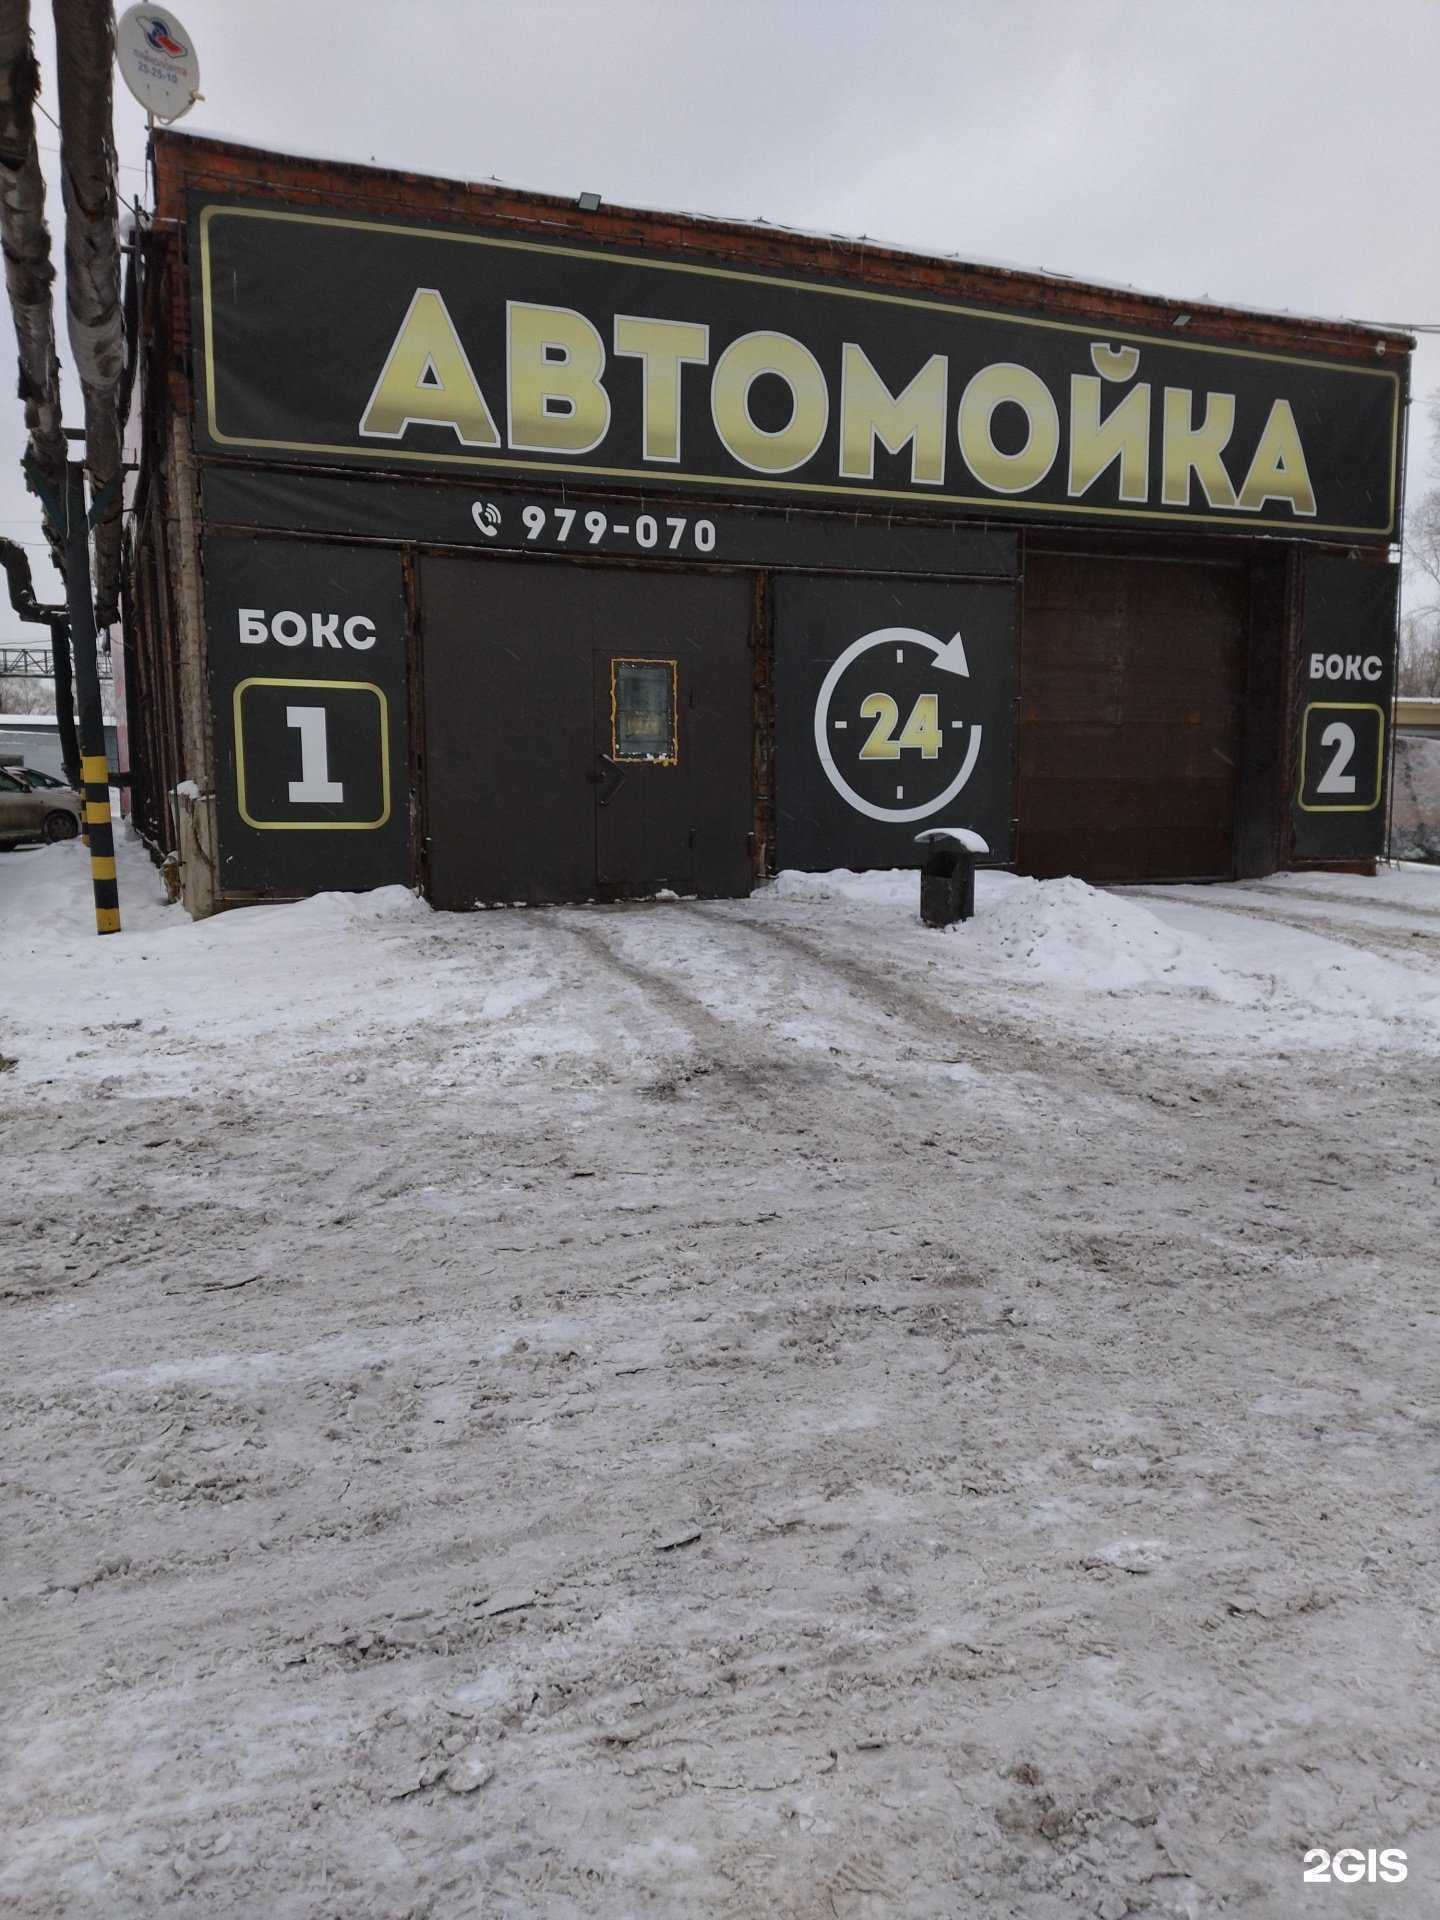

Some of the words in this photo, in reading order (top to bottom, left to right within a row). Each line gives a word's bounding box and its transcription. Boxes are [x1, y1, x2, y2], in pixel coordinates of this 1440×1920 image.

[358, 286, 1318, 518] АВТОМОЙКА
[521, 505, 716, 552] 979-070
[238, 608, 377, 650] БОКС
[1309, 652, 1383, 682] БОКС
[286, 706, 344, 803] 1
[858, 692, 943, 760] 24
[1316, 722, 1357, 793] 2
